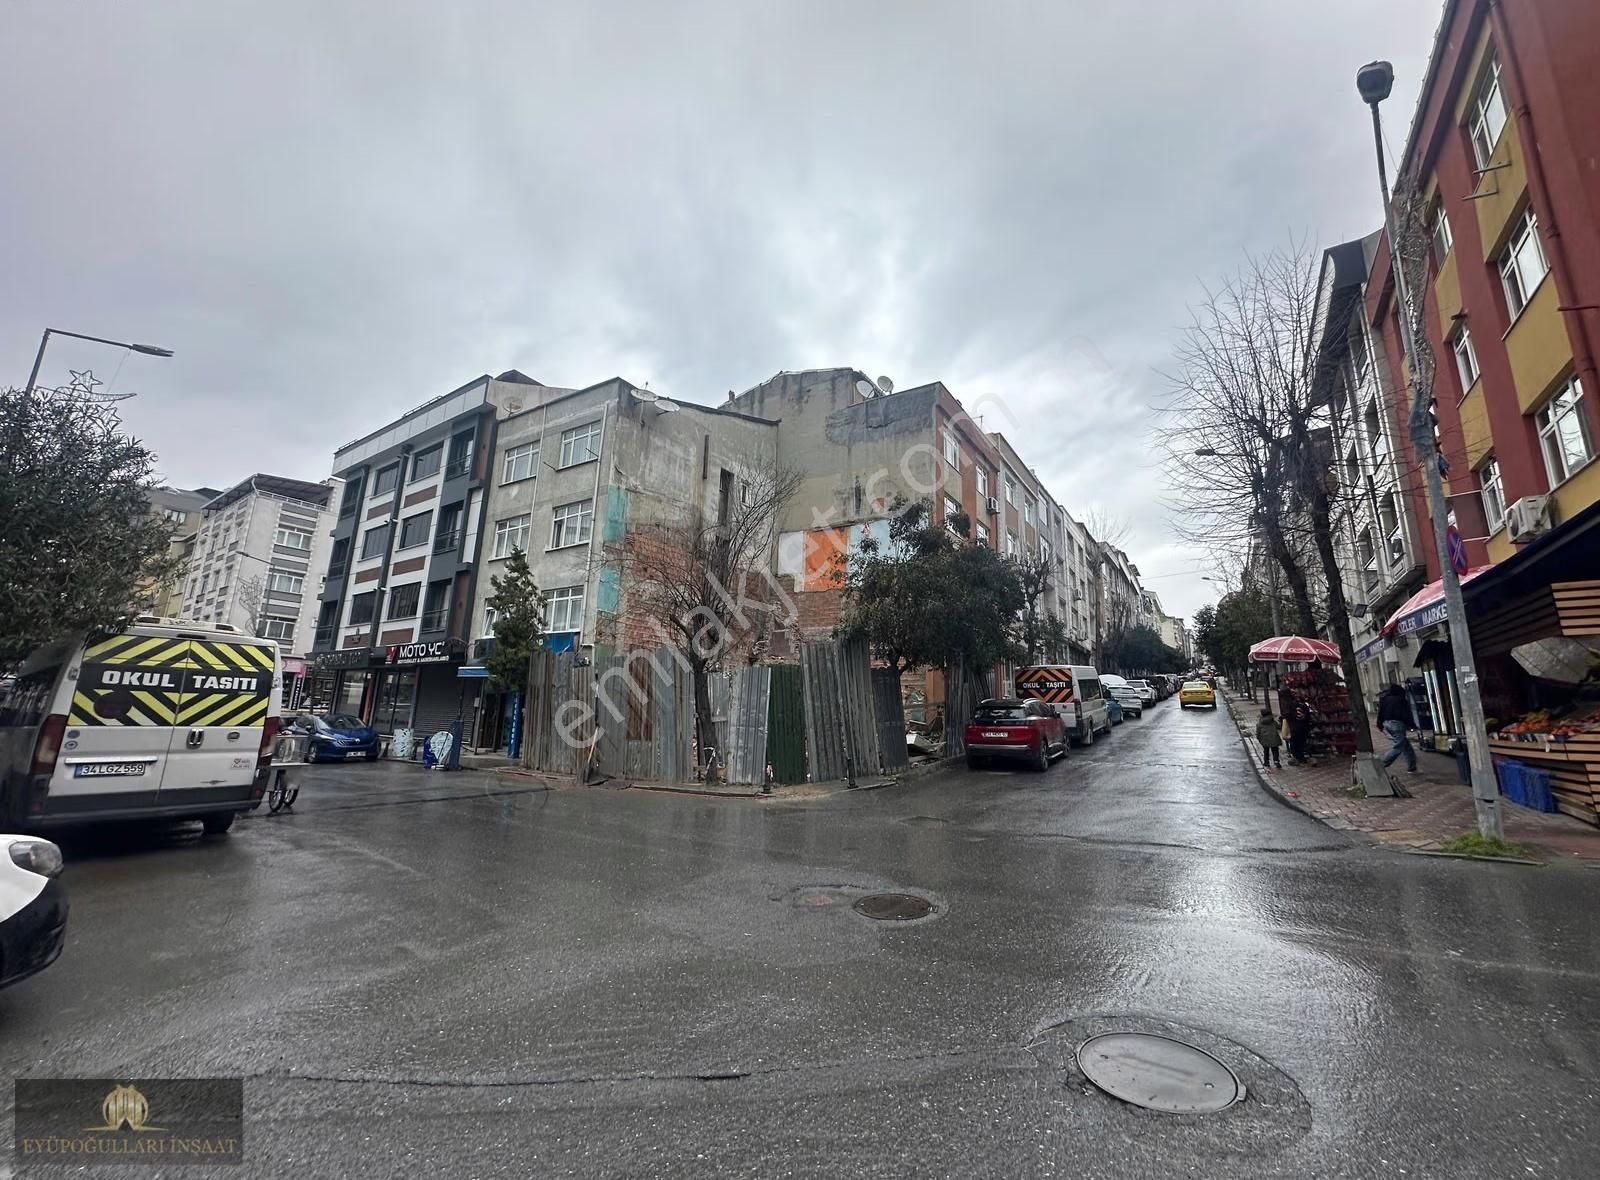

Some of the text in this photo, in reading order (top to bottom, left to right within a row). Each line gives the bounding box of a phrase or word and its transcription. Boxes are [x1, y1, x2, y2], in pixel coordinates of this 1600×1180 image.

[1422, 603, 1448, 625] MARKE
[399, 644, 426, 658] MOTO
[101, 670, 175, 687] OKUL
[83, 765, 96, 774] 34
[124, 764, 144, 773] 559
